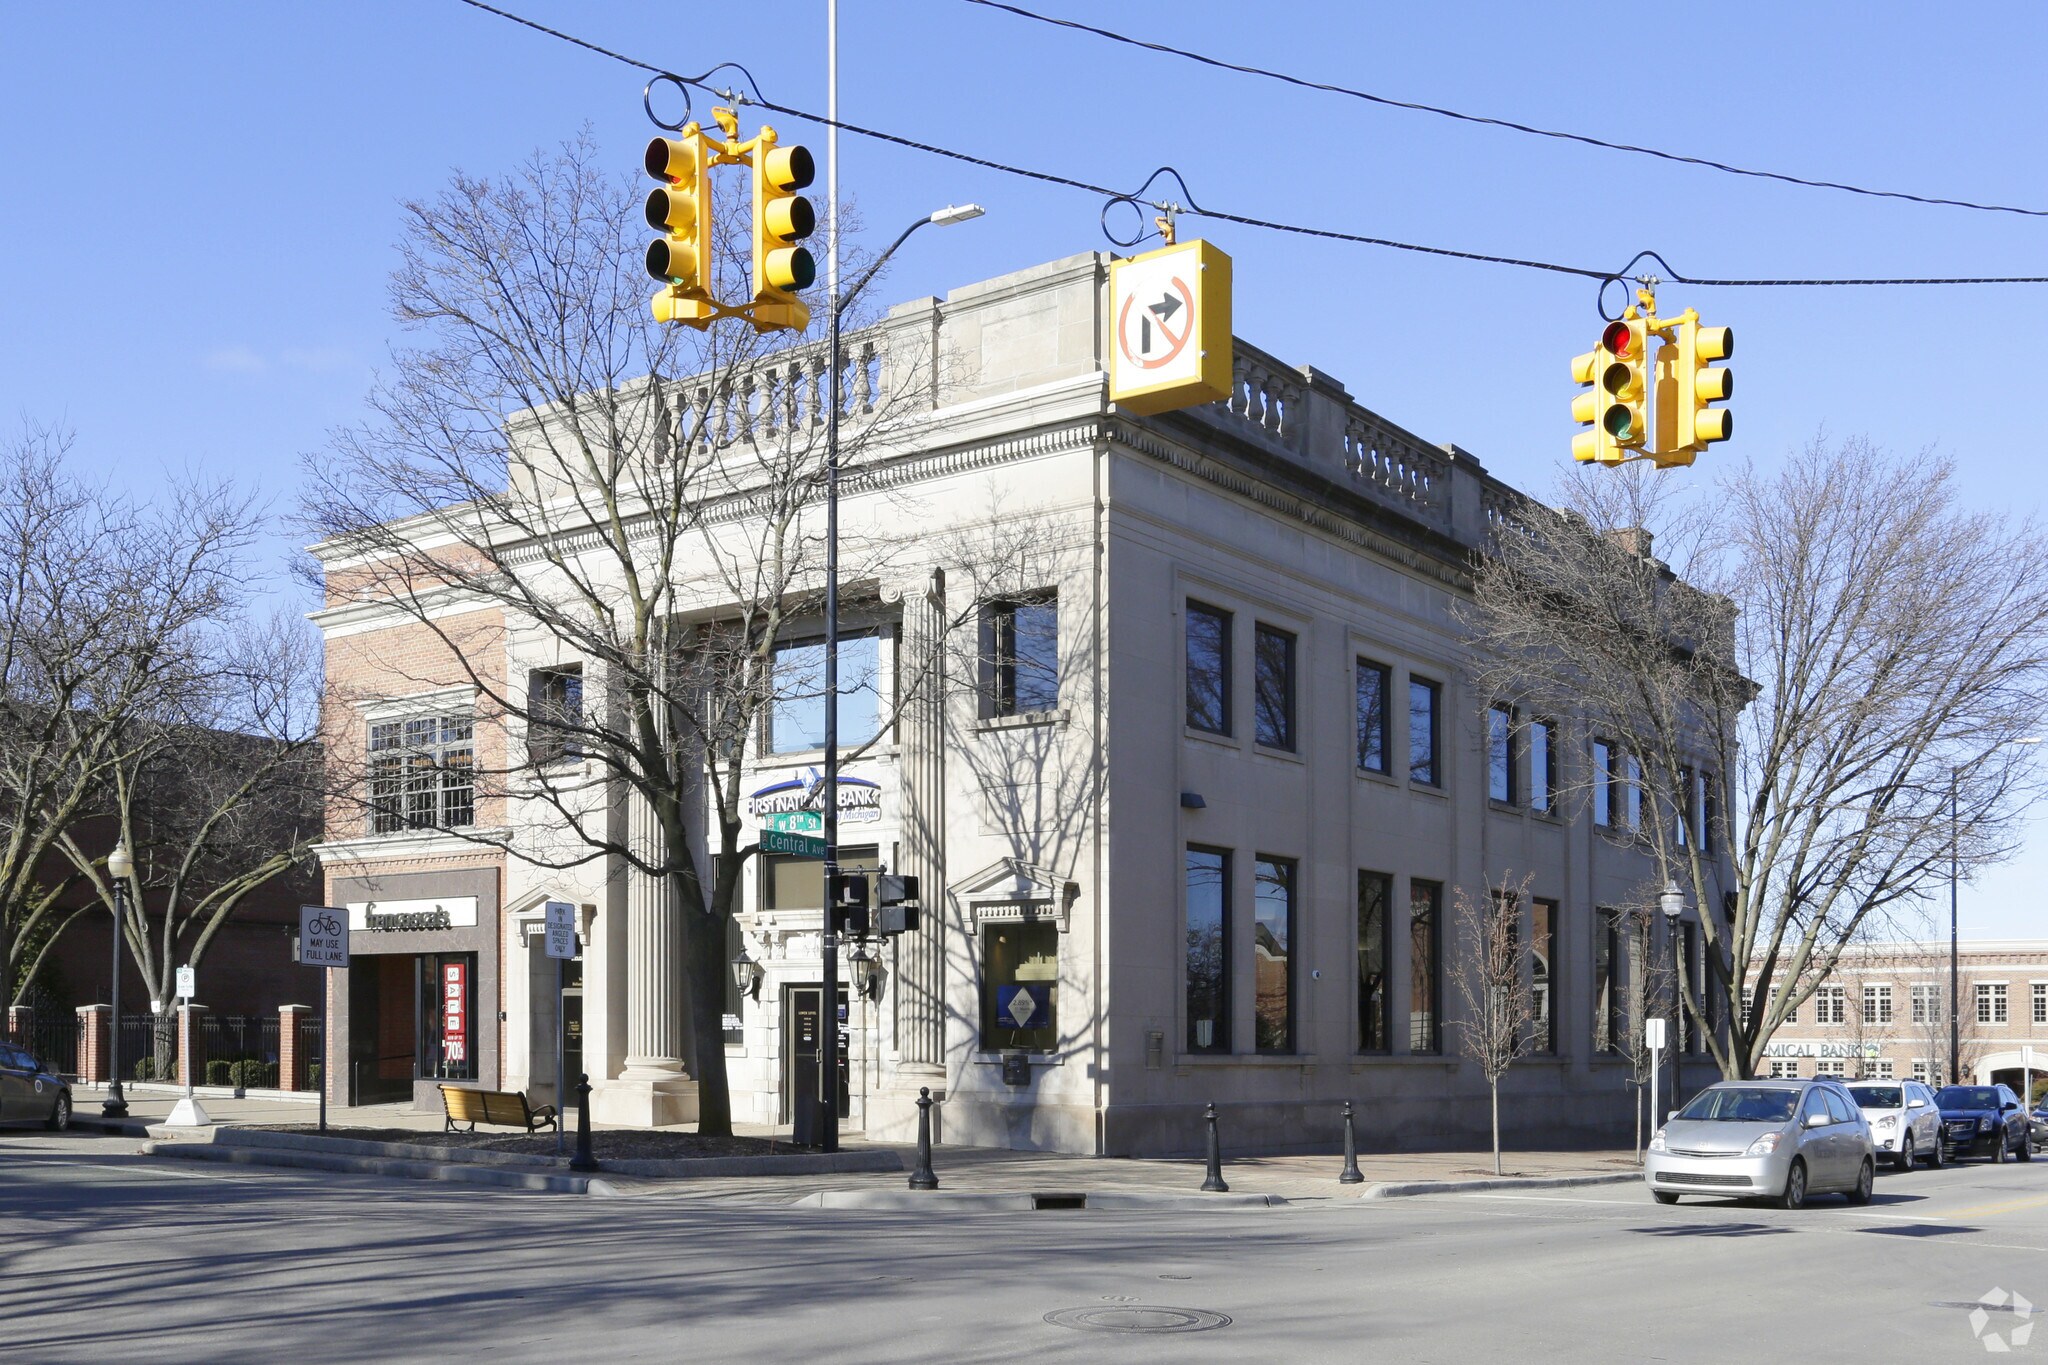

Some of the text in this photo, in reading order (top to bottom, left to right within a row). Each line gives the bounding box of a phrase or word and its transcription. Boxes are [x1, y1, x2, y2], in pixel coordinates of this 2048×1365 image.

[748, 796, 775, 814] FIRST
[840, 789, 873, 806] BANK
[844, 809, 879, 821] Michigan
[779, 820, 786, 831] W
[789, 814, 804, 830] 8TH
[808, 817, 816, 829] St
[770, 833, 808, 853] Central
[812, 844, 825, 855] Ave
[547, 921, 572, 931] DESIGNATED
[310, 938, 323, 948] MAY
[325, 939, 339, 949] USE
[552, 937, 569, 946] SPACES
[306, 950, 342, 962] FULL LANE
[446, 1041, 464, 1060] 70%
[1820, 1043, 1861, 1058] BANK
